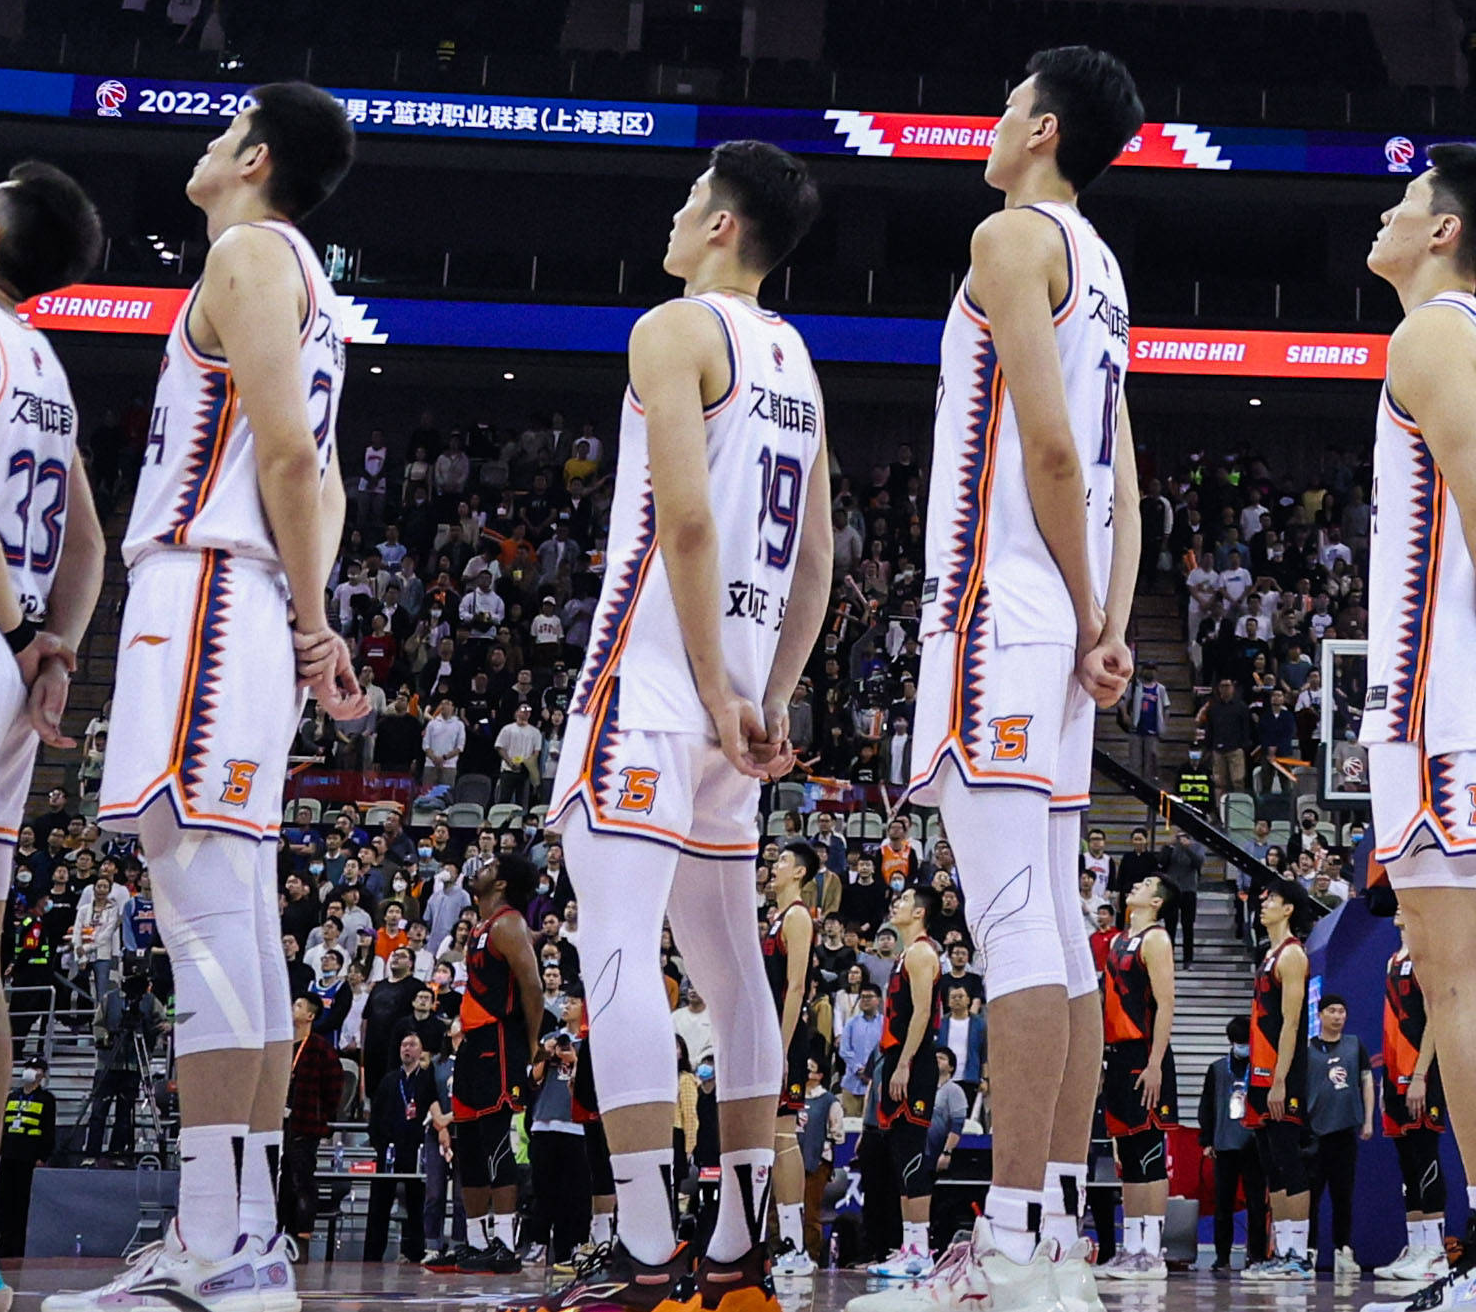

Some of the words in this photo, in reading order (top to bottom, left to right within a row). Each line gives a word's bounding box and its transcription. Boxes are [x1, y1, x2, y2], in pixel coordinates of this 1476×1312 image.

[344, 96, 655, 138] 男子篮球职业联赛(上海赛区)
[901, 125, 999, 148] SHANGHA
[35, 293, 153, 321] SHANGHAI
[1135, 338, 1246, 364] SHANGHAI
[1286, 342, 1369, 366] SHARKS
[1, 447, 69, 574] 33
[754, 445, 804, 572] 19
